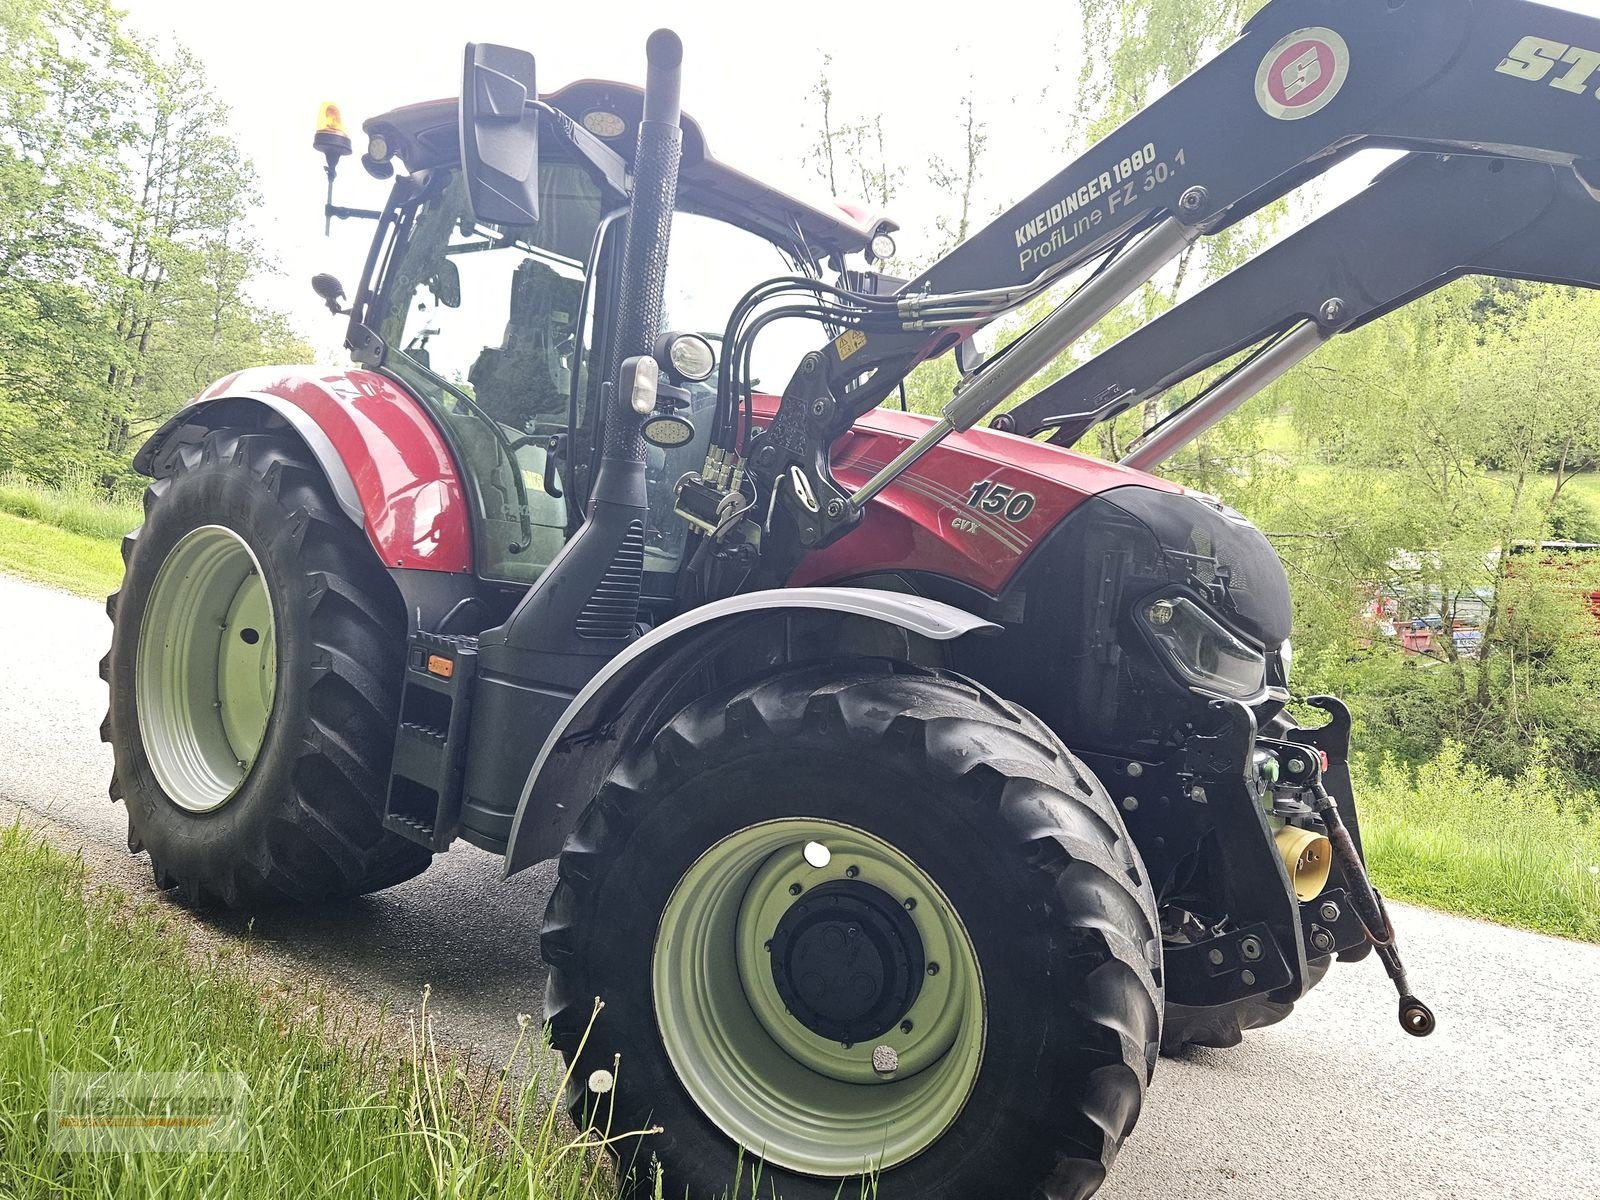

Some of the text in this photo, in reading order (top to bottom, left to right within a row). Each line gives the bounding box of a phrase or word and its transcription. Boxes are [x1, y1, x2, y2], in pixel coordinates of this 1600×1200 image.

[1494, 35, 1600, 100] ST
[1014, 142, 1156, 248] KNEIDINGER 1880
[1019, 208, 1103, 272] ProfiLine
[1107, 181, 1138, 215] FZ
[951, 517, 979, 534] CVX
[966, 479, 1036, 523] 150
